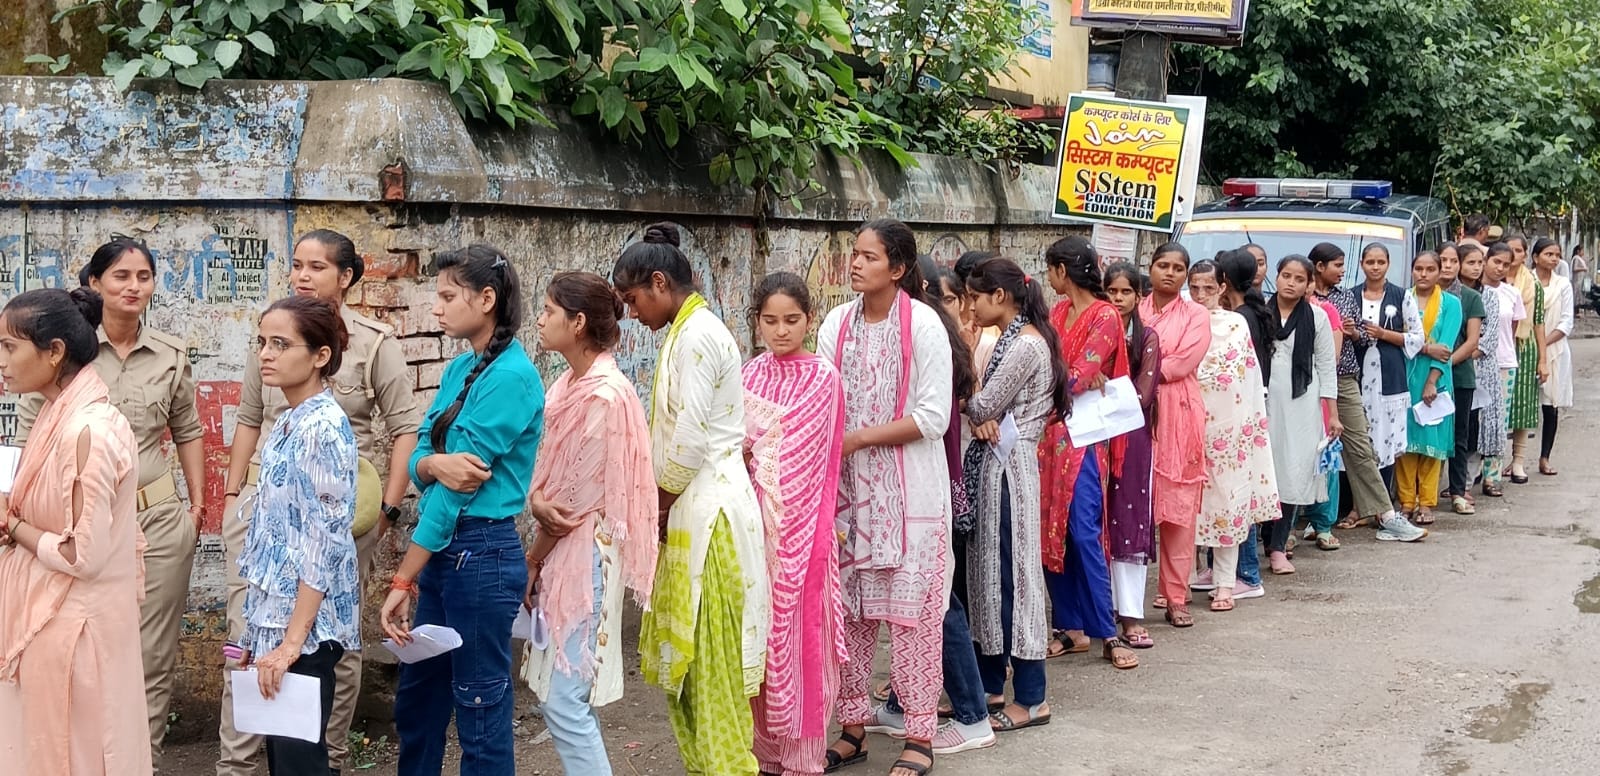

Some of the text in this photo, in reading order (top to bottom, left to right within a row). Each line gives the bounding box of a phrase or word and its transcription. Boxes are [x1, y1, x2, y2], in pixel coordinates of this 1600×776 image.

[1084, 107, 1172, 125] कम्प्यूटर कोर्स के लिए
[1066, 140, 1177, 181] सिस्टम कम्प्यूटर
[1075, 169, 1157, 200] SiStem
[1085, 193, 1156, 210] COMPUTER
[1084, 202, 1155, 220] EDUCATION
